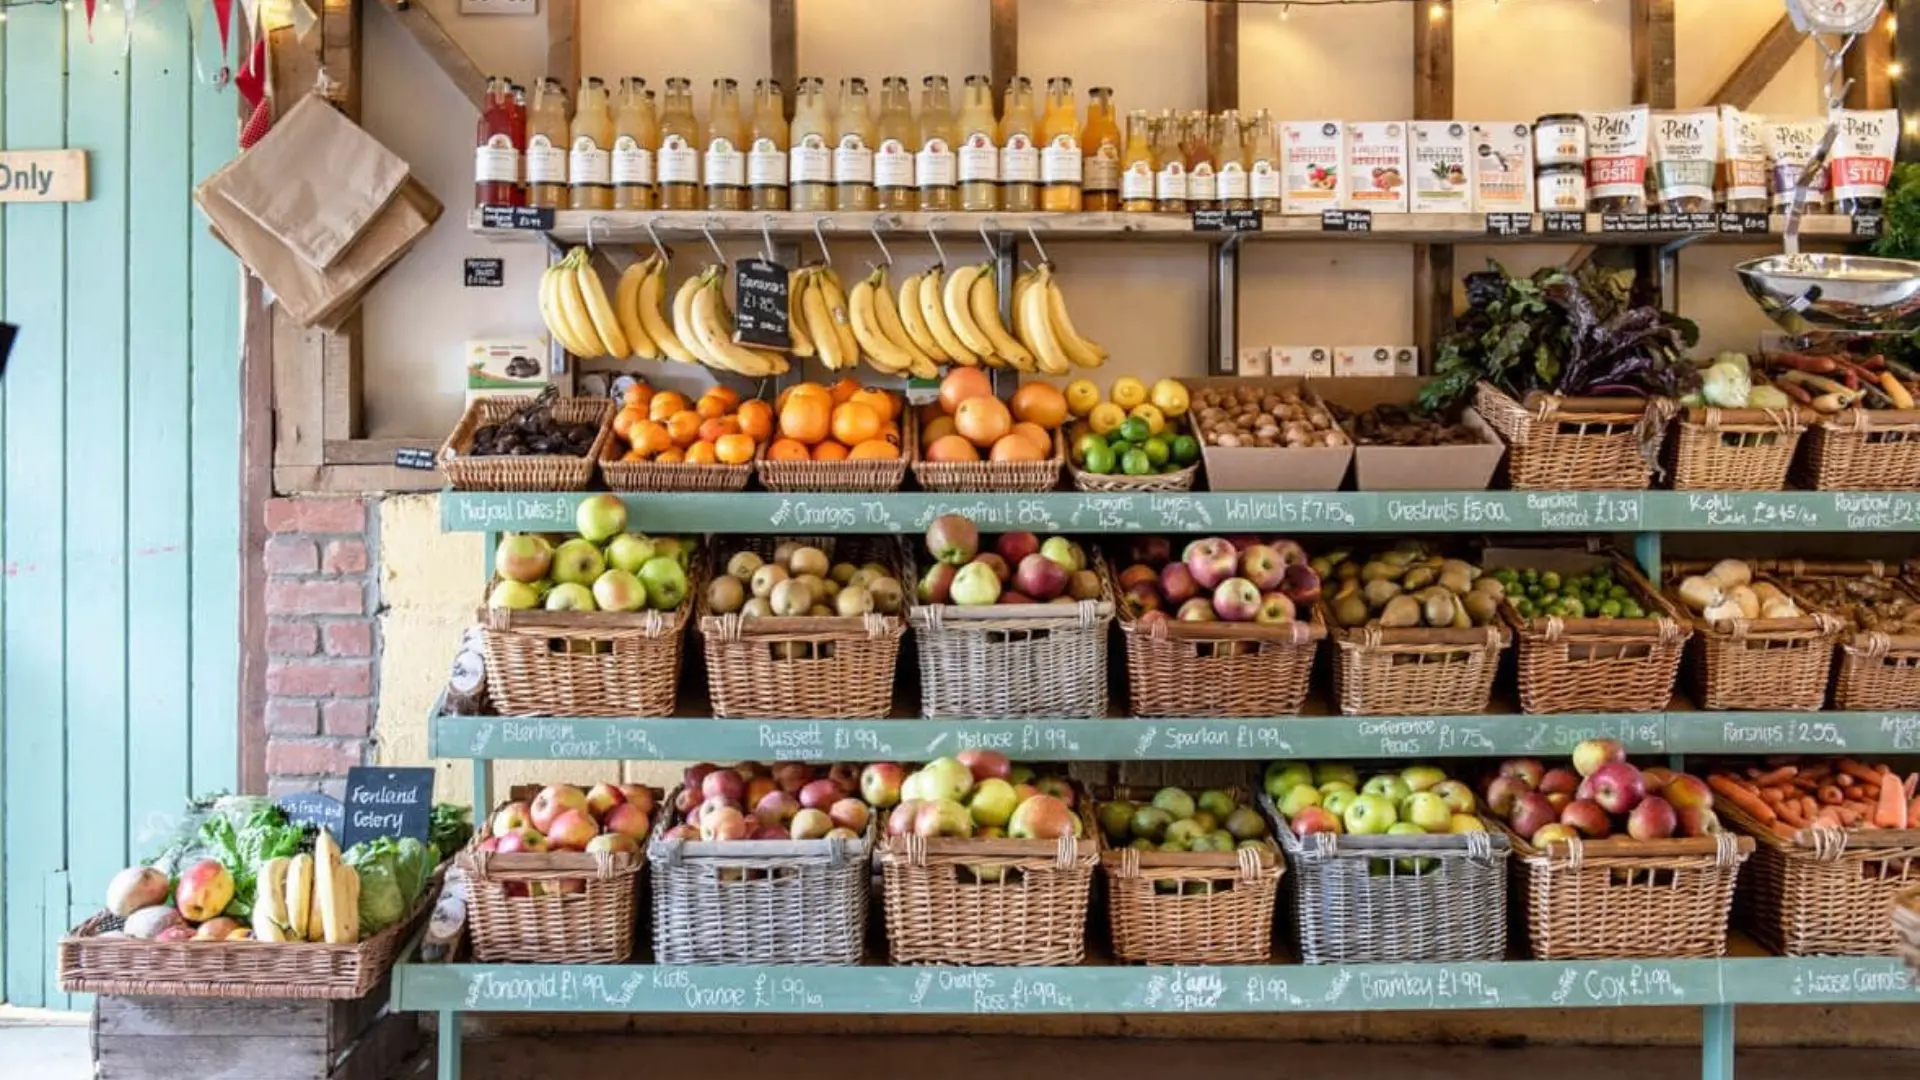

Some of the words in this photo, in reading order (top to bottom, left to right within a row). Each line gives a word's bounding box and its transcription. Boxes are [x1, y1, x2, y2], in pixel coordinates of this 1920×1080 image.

[0, 162, 54, 196] Only
[794, 501, 856, 529] Oranges
[1225, 495, 1297, 521] Walnuts
[1388, 496, 1459, 523] Chestnuts
[1595, 495, 1638, 524] £1.39
[1164, 727, 1229, 750] Spartan
[1358, 719, 1436, 736] Conference
[1723, 720, 1783, 746] Parsnips
[1380, 737, 1420, 754] Pears
[352, 784, 419, 805] Fenland
[353, 811, 404, 837] Celery
[685, 982, 746, 1008] Orange
[1360, 969, 1432, 1007] Bramley
[1583, 968, 1629, 1006] Cox
